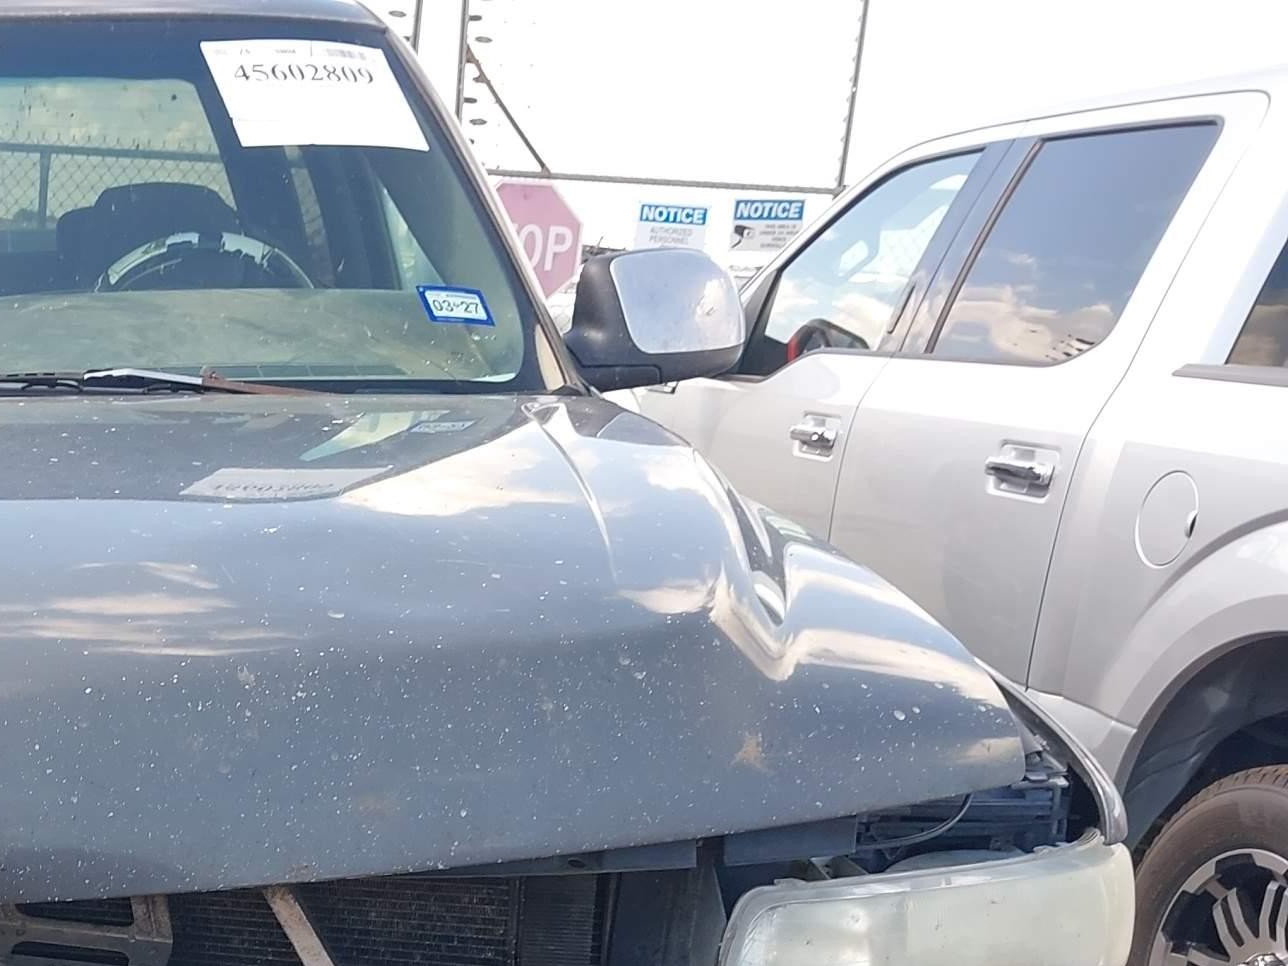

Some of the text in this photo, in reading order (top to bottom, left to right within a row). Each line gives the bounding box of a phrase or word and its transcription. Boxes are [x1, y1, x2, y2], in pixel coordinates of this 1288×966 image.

[233, 63, 374, 85] 45602809
[642, 205, 705, 224] NOTICE
[736, 202, 803, 218] NOTICE
[514, 223, 573, 272] OP
